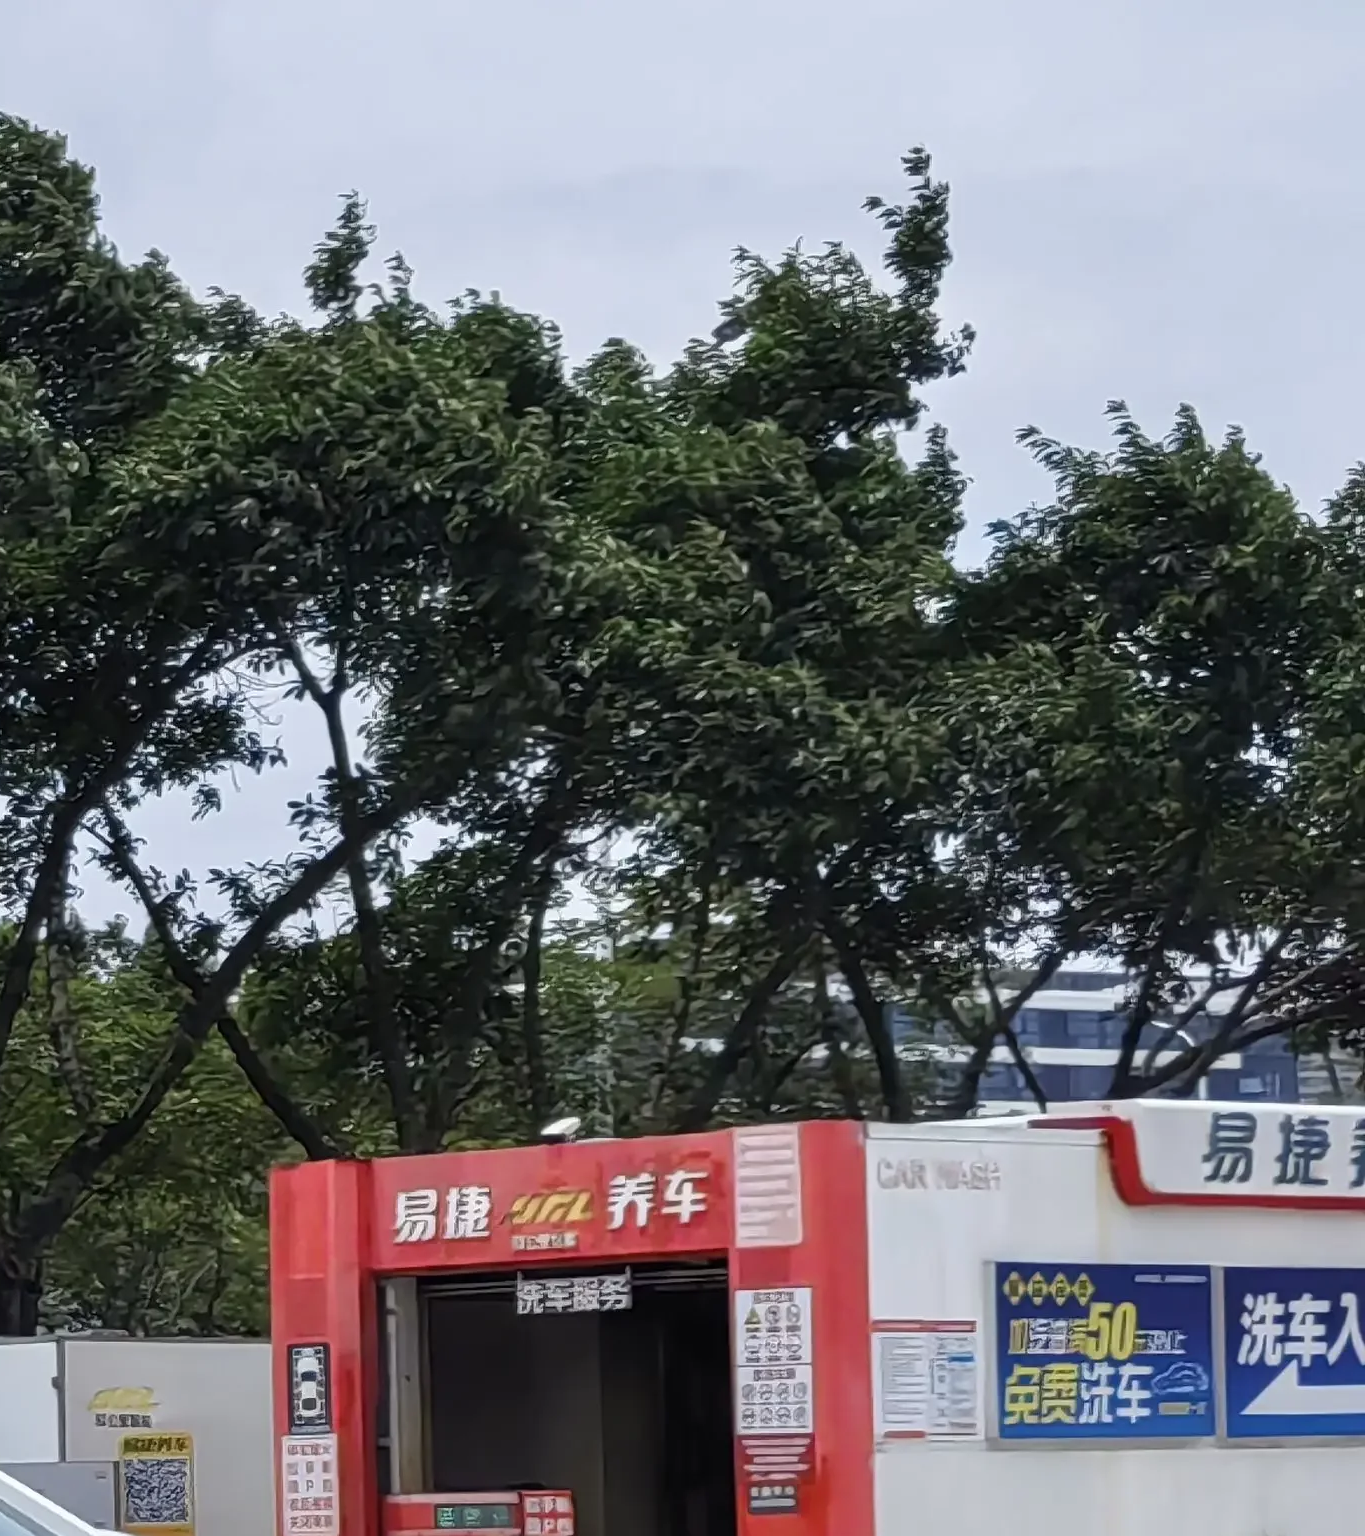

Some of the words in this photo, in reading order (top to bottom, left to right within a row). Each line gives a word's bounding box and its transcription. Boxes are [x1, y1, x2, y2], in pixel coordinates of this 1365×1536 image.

[393, 1187, 492, 1244] 易捷
[606, 1169, 708, 1231] 养车
[877, 1158, 928, 1190] CAR
[1237, 1292, 1365, 1367] 洗车入
[1004, 1361, 1154, 1425] 免费洗车
